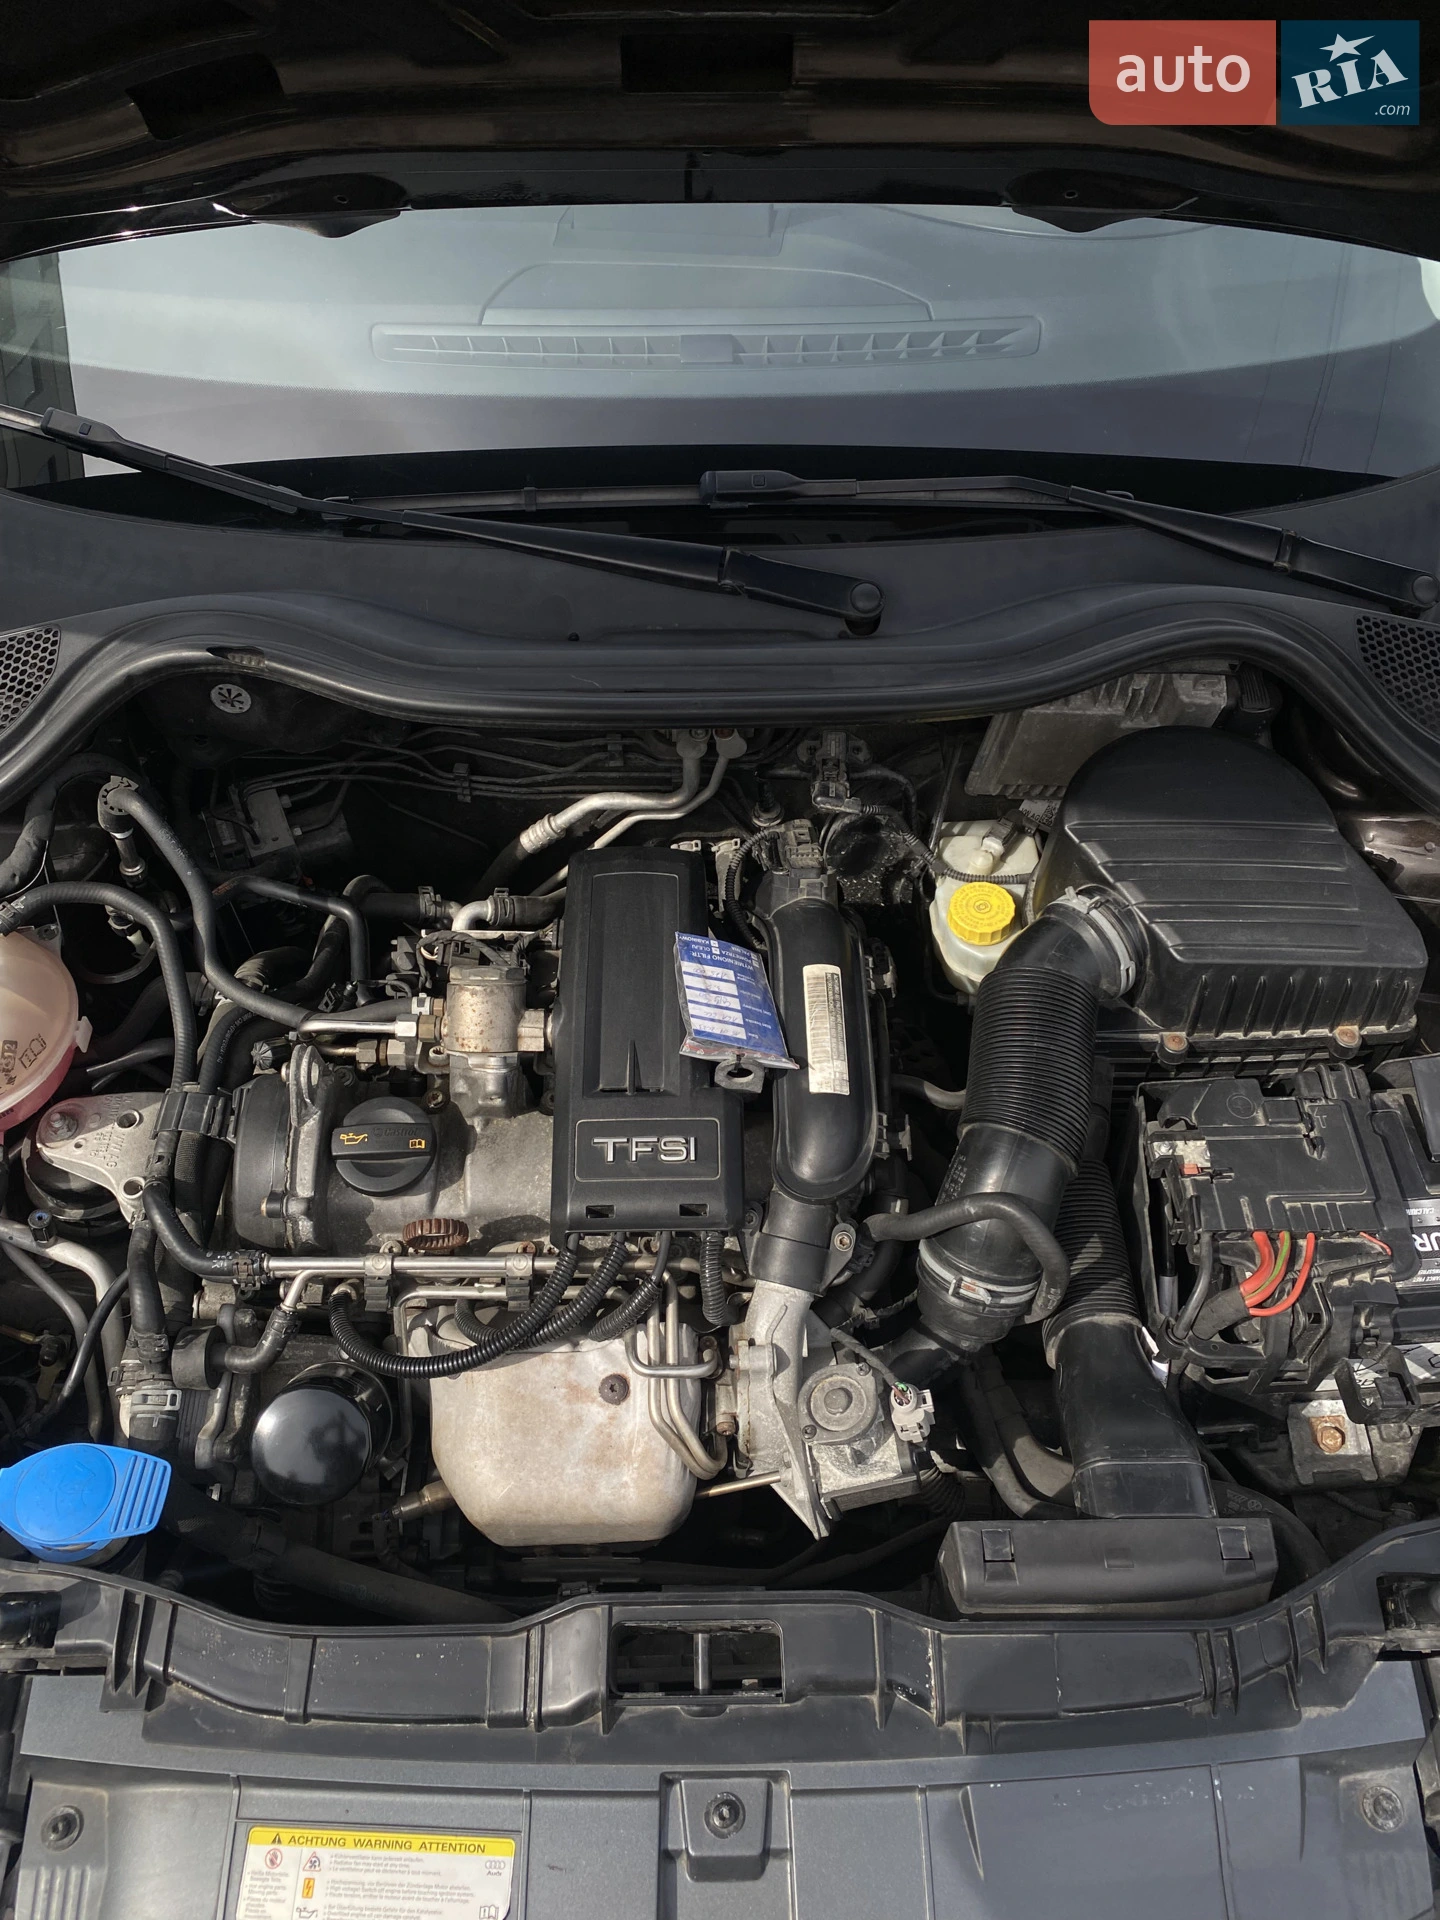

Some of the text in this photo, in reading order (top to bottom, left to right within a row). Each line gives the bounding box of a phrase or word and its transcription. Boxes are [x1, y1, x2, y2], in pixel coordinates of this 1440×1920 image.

[712, 954, 754, 971] WYMIENIONO
[384, 1126, 418, 1138] Castrol
[592, 1136, 697, 1163] TFSI
[288, 1836, 486, 1854] ACHTUNG WARNING ATTENTION
